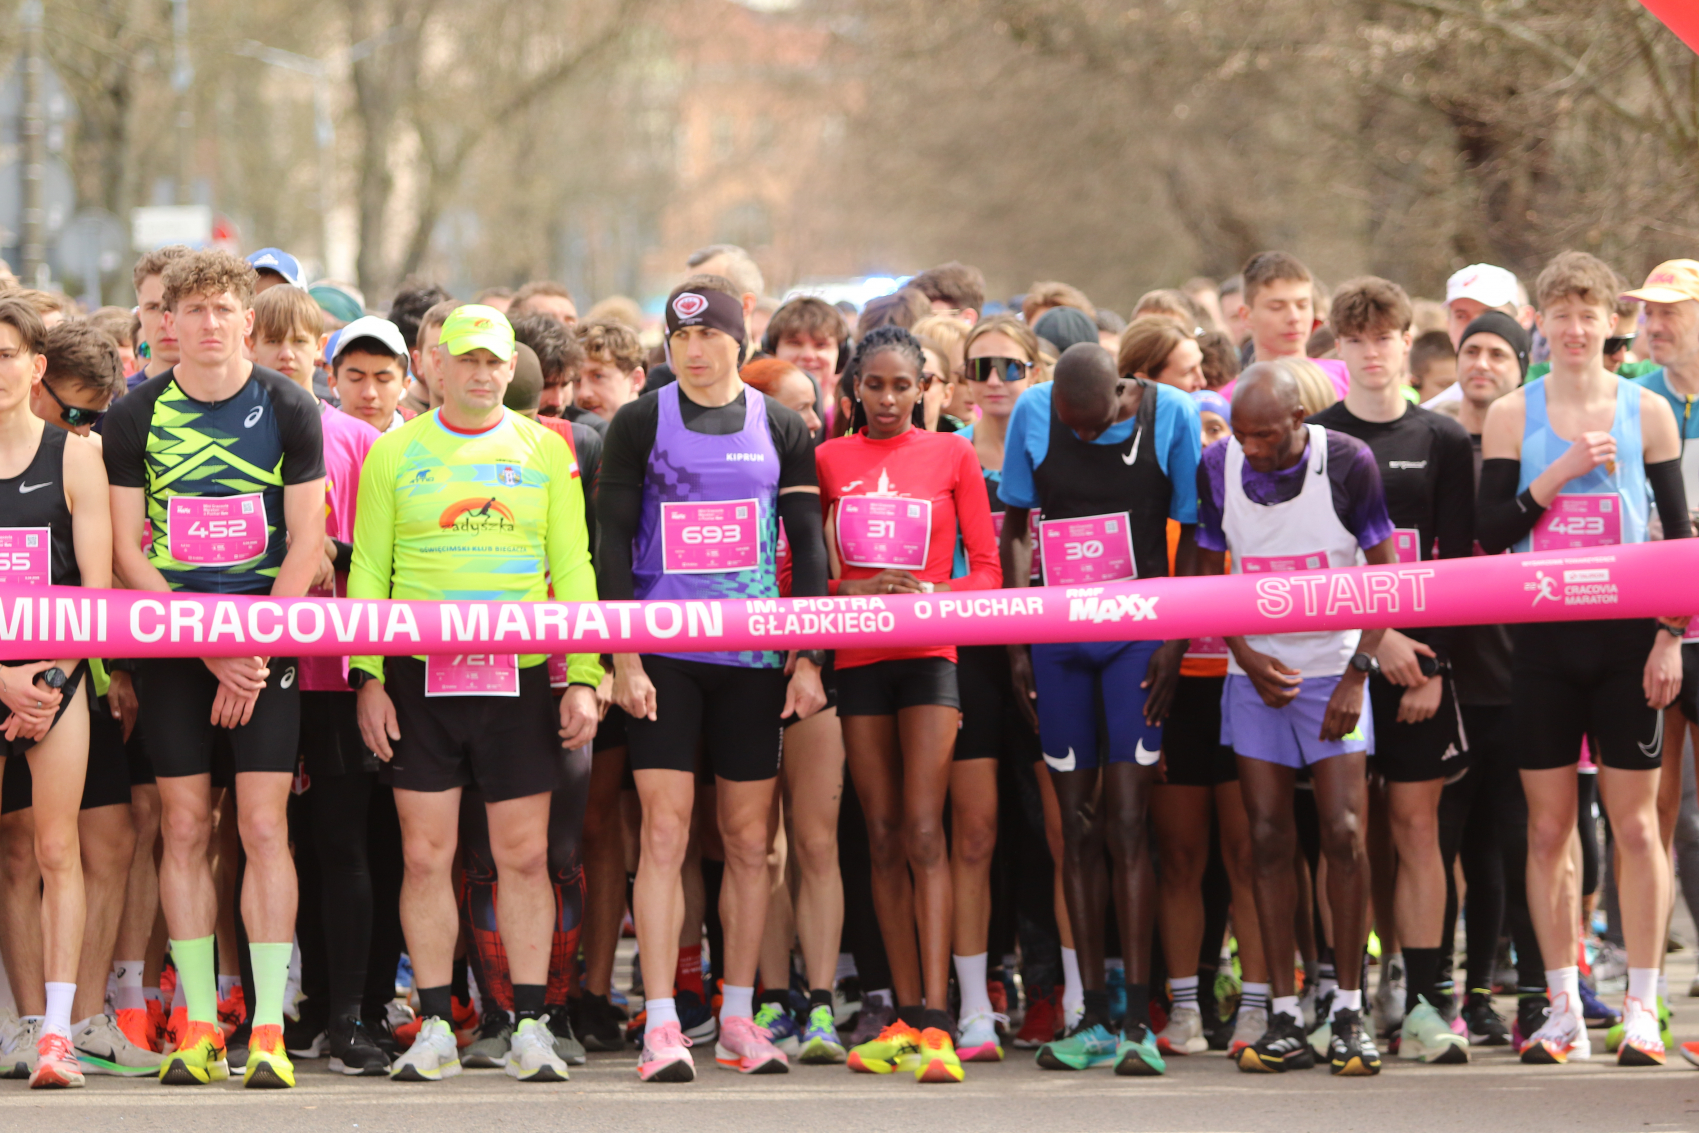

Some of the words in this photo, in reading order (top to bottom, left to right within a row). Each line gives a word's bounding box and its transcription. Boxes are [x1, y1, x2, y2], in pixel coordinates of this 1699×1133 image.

[726, 453, 765, 462] KIPRUN
[188, 519, 247, 538] 452
[440, 517, 515, 536] zadyszka
[682, 524, 741, 544] 693
[867, 520, 895, 538] 31
[1548, 517, 1605, 535] 423
[1064, 540, 1104, 560] 30
[1066, 587, 1105, 598] RMF
[1256, 569, 1435, 619] START
[1564, 583, 1618, 595] CRACOVIA
[746, 600, 785, 613] IM.
[792, 597, 886, 612] PIOTRA
[914, 601, 932, 619] O
[939, 597, 1044, 618] PUCHAR
[1068, 593, 1159, 623] MAXX
[1565, 595, 1618, 605] MARATON
[0, 597, 107, 642] MINI
[129, 599, 421, 643] CRACOVIA
[440, 601, 723, 641] MARATON
[748, 611, 895, 636] GŁADKIEGO
